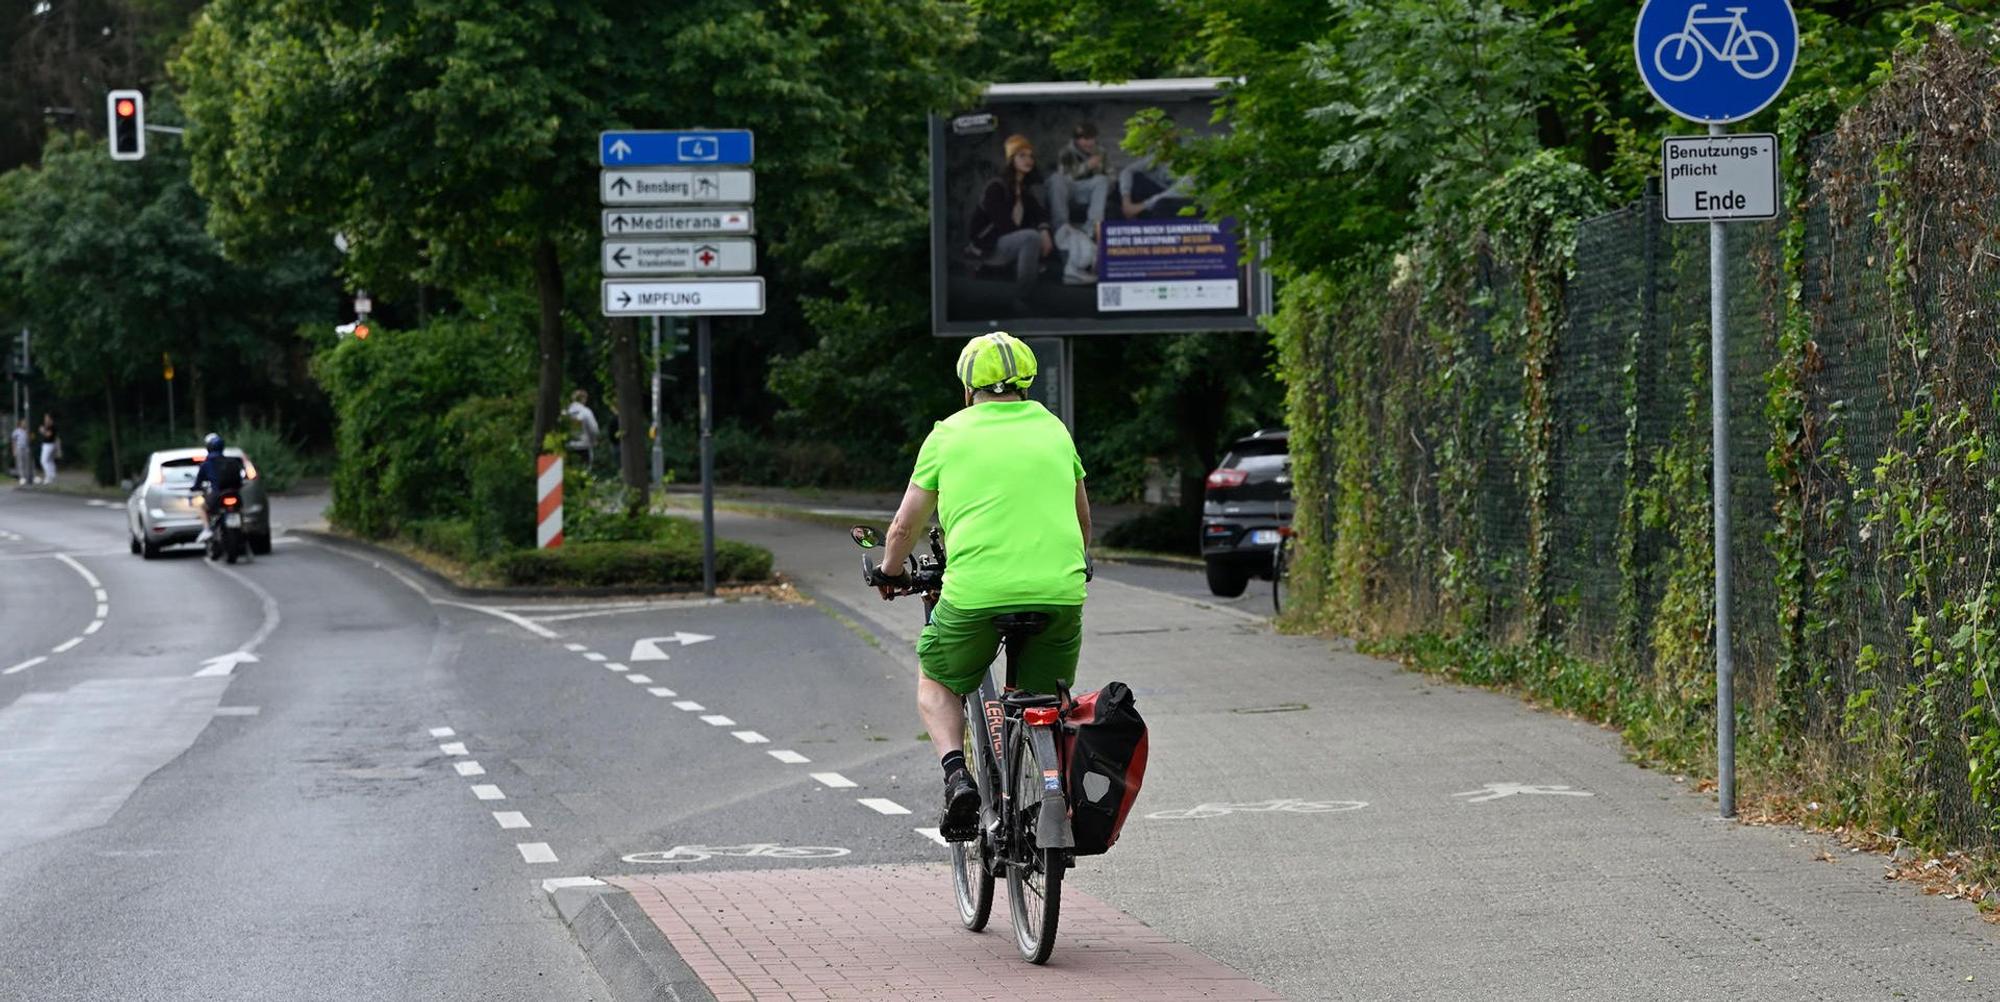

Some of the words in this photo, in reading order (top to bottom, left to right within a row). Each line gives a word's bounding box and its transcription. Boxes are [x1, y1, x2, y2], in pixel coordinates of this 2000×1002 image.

[692, 142, 703, 156] 4
[1671, 163, 1718, 179] pflicht
[636, 179, 689, 196] Bensberg
[1695, 190, 1746, 211] Ende
[631, 215, 721, 230] Mediterana
[638, 291, 701, 306] IMPFUNG
